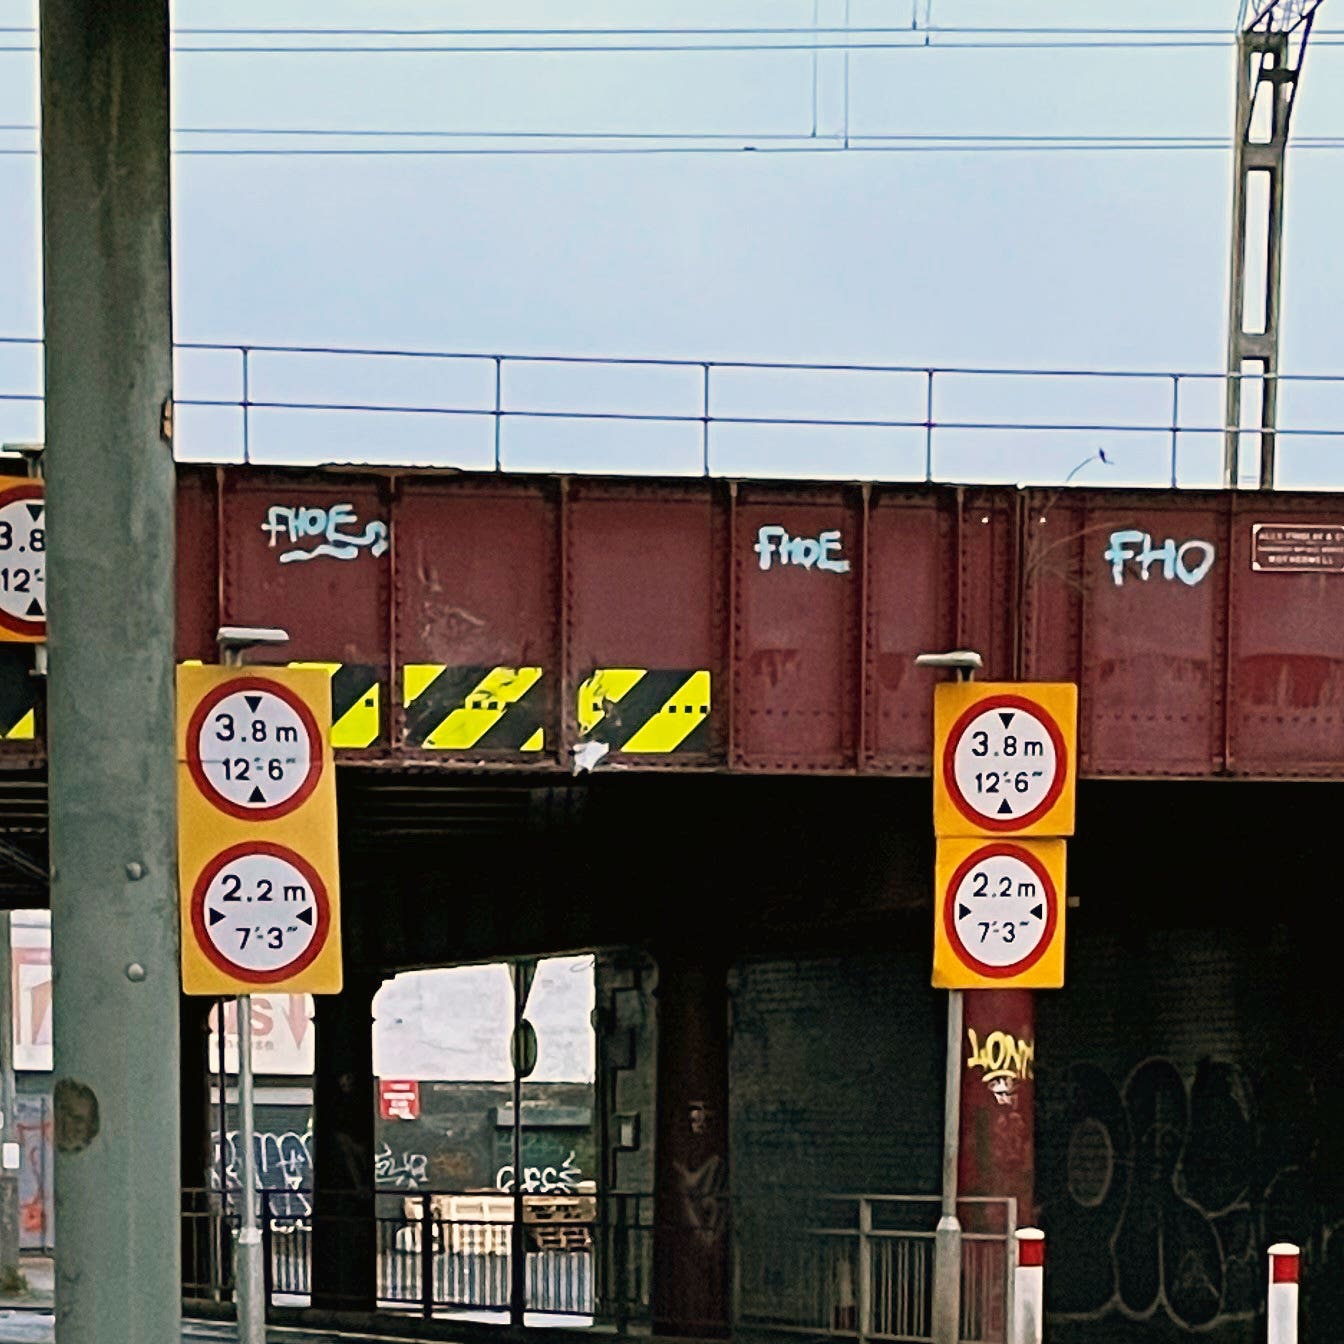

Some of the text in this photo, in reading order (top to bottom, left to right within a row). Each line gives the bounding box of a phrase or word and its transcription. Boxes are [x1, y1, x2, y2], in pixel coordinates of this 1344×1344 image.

[215, 713, 298, 743] 3.8 m
[971, 731, 1044, 757] 3.8 m
[221, 874, 306, 902] 2.2 m
[972, 872, 1036, 898] 2.2 m
